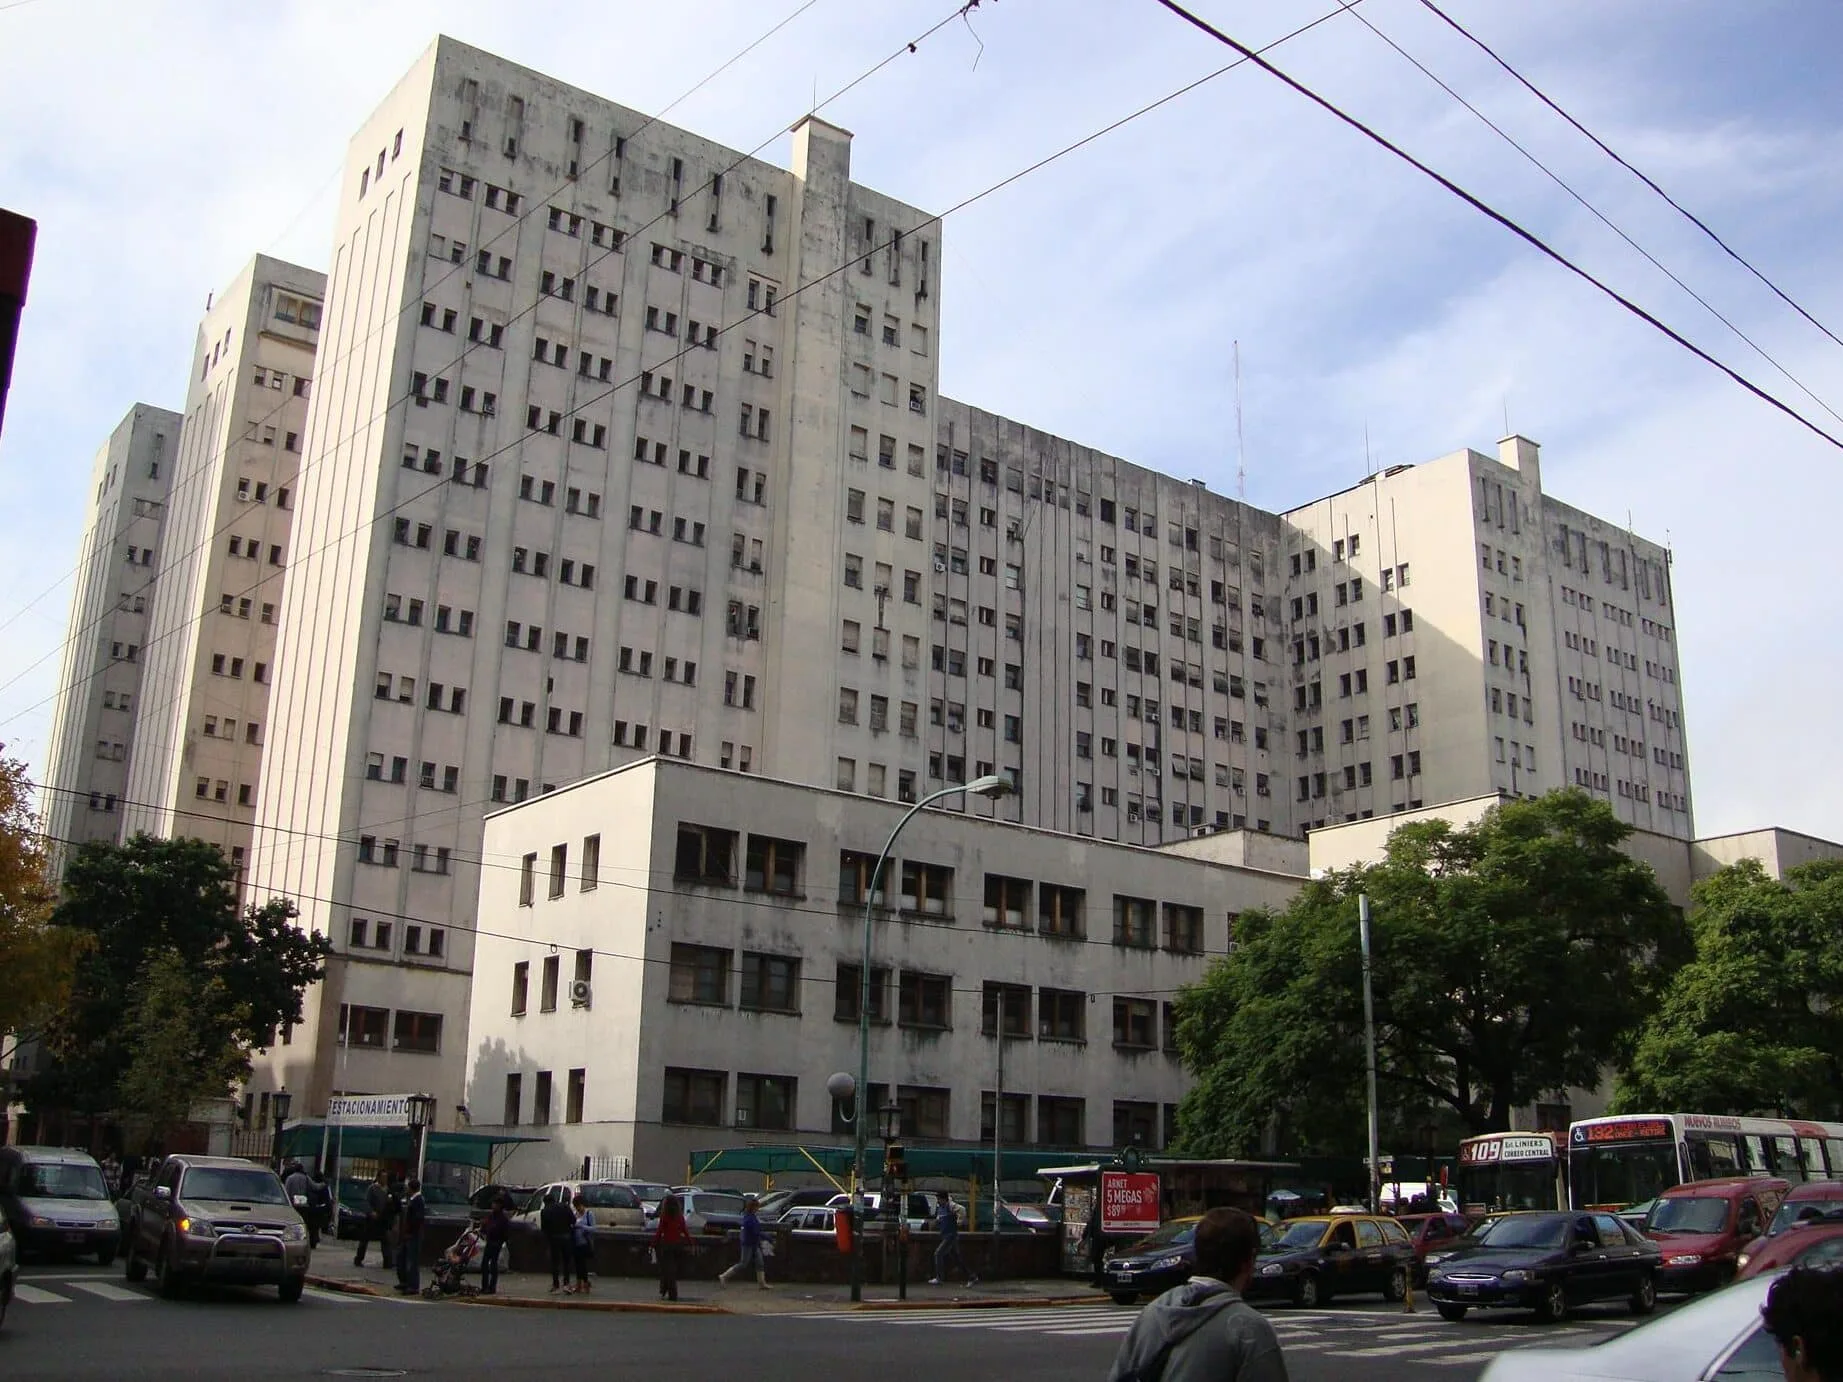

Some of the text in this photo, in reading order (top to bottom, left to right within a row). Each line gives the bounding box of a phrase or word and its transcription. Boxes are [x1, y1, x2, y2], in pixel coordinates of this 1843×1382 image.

[332, 1100, 410, 1114] ESTACIONAMIENTO
[1587, 1124, 1614, 1140] 132
[1471, 1141, 1501, 1160] 109
[1107, 1179, 1127, 1188] ARNET
[1107, 1190, 1142, 1203] 5 MEGAS
